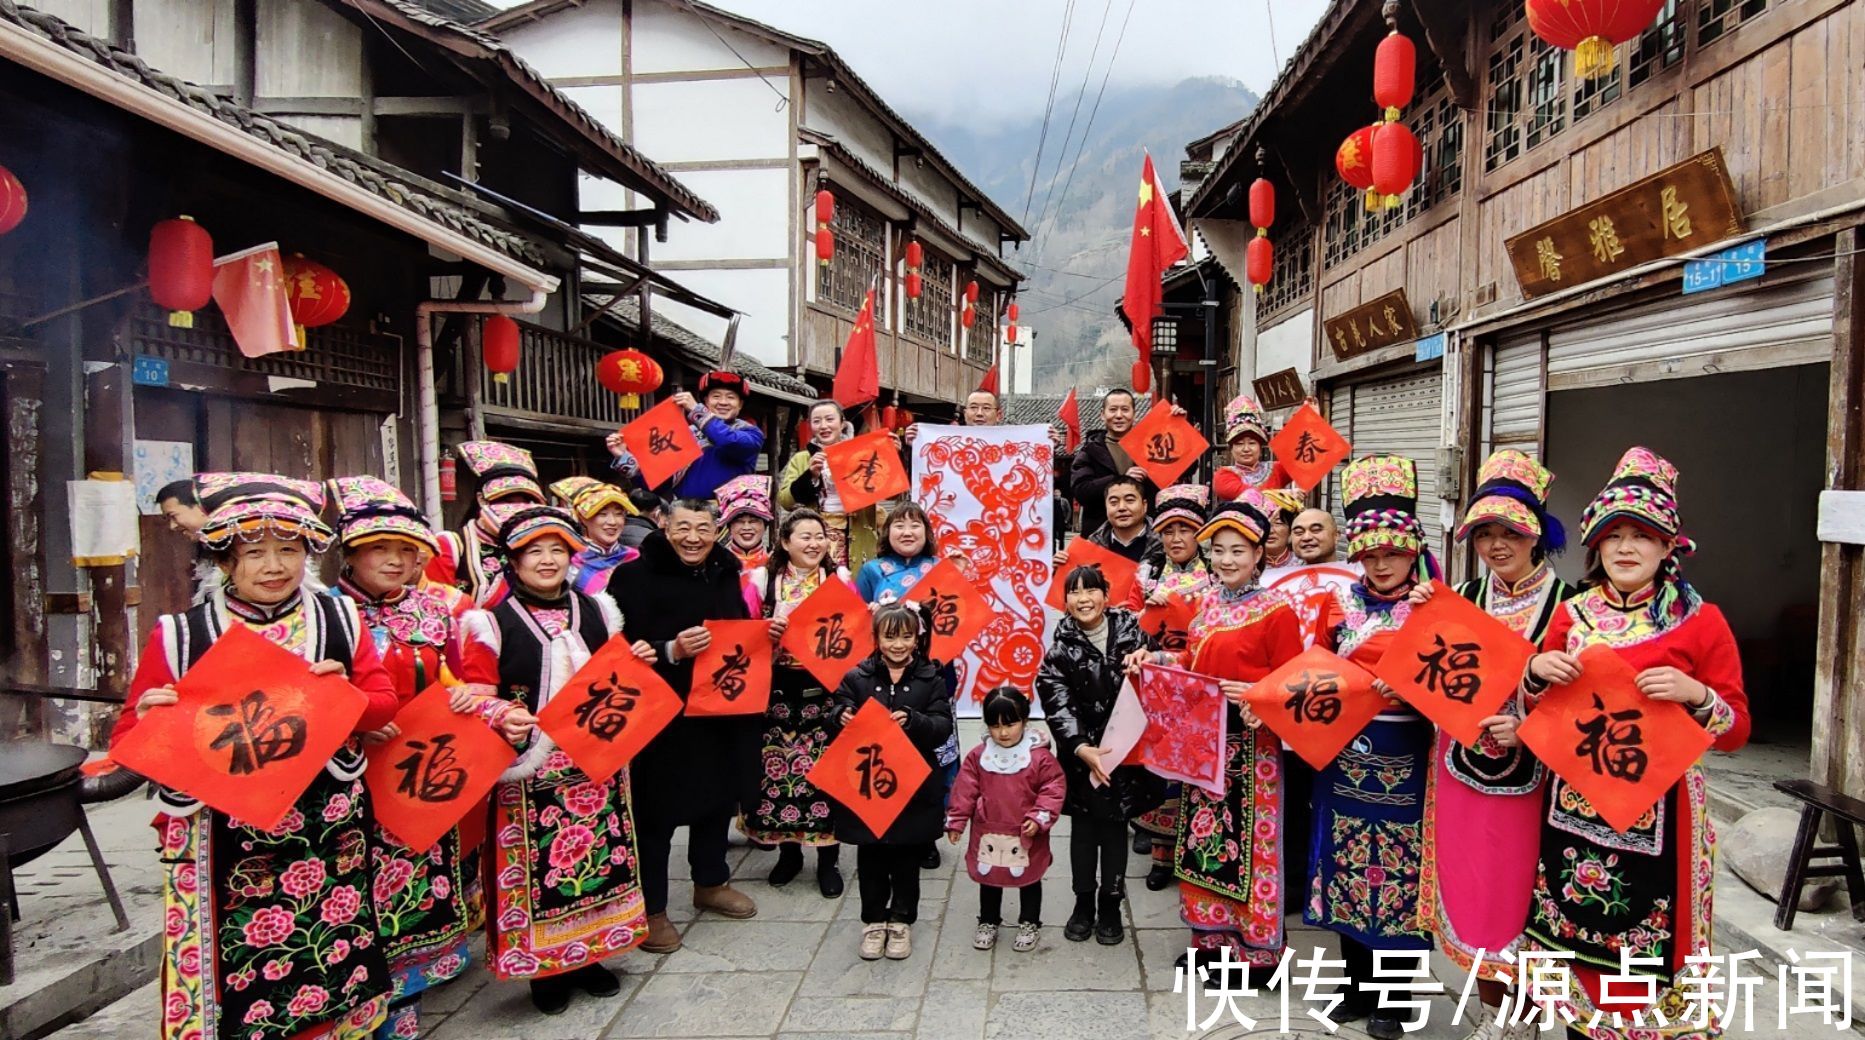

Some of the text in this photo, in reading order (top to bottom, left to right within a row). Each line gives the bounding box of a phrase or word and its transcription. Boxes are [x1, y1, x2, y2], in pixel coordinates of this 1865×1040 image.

[1689, 268, 1716, 287] 15-1
[1735, 258, 1752, 274] 15
[145, 370, 159, 381] 10
[1146, 432, 1180, 465] 迎
[1293, 430, 1329, 464] 春
[816, 613, 852, 660] 福
[928, 588, 960, 636] 福
[712, 645, 749, 702] 福
[1414, 634, 1482, 704] 福
[574, 672, 641, 742] 福
[1284, 671, 1342, 725] 福
[208, 689, 307, 775] 福
[1575, 693, 1649, 784] 福
[395, 733, 468, 802] 福
[855, 742, 897, 800] 福
